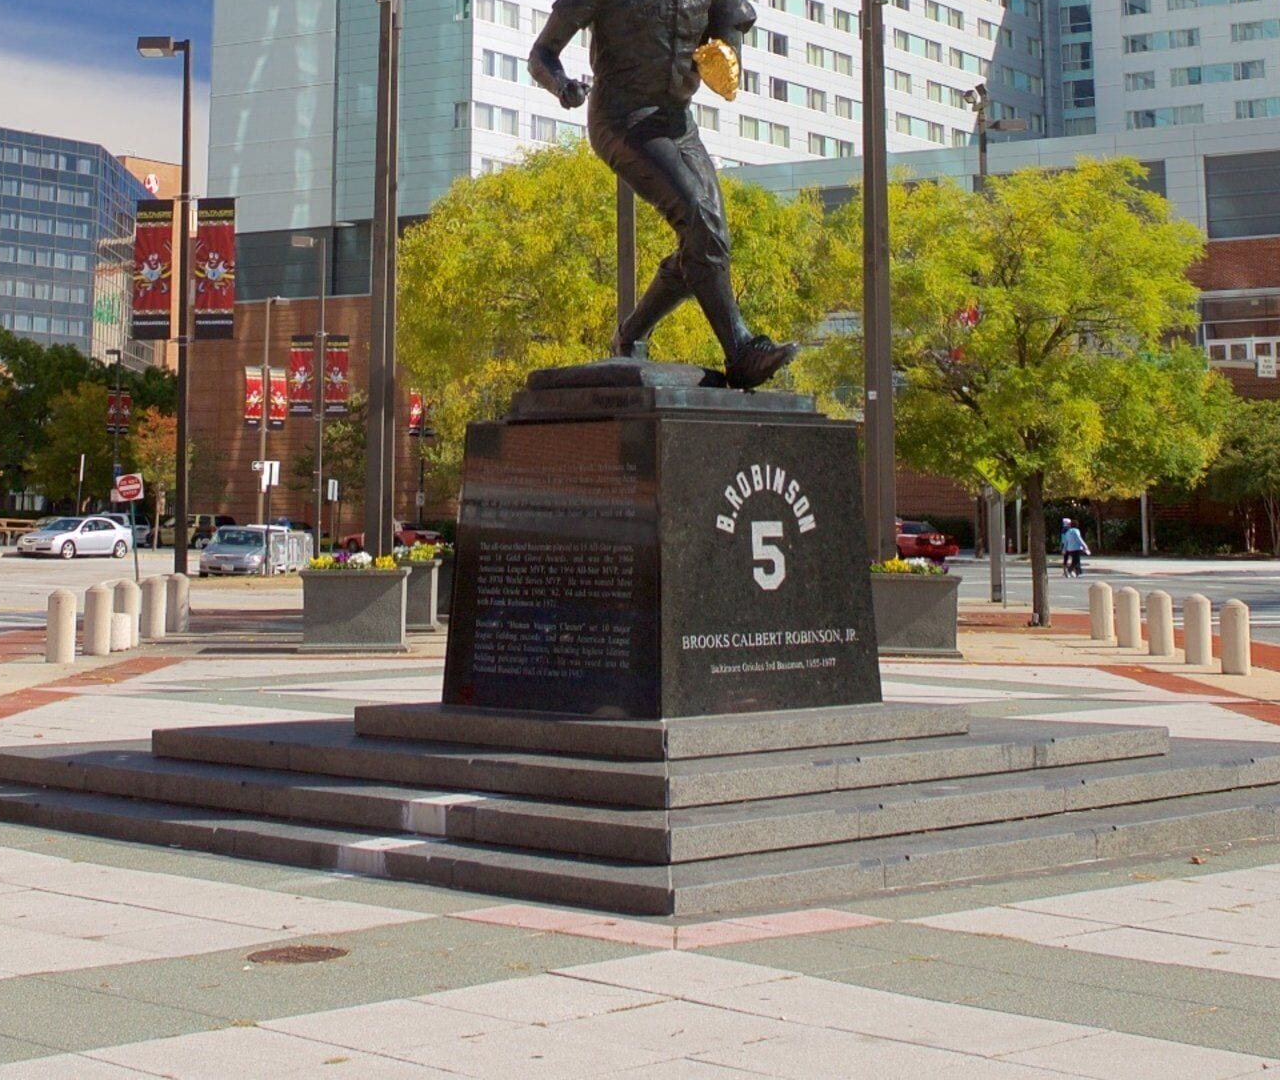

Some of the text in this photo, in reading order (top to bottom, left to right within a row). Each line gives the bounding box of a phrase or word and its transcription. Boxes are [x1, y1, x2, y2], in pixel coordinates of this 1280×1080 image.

[751, 521, 786, 591] 5
[682, 628, 860, 650] BROOKS CALBERT ROBINSON, JR.
[710, 663, 741, 674] Baltimore
